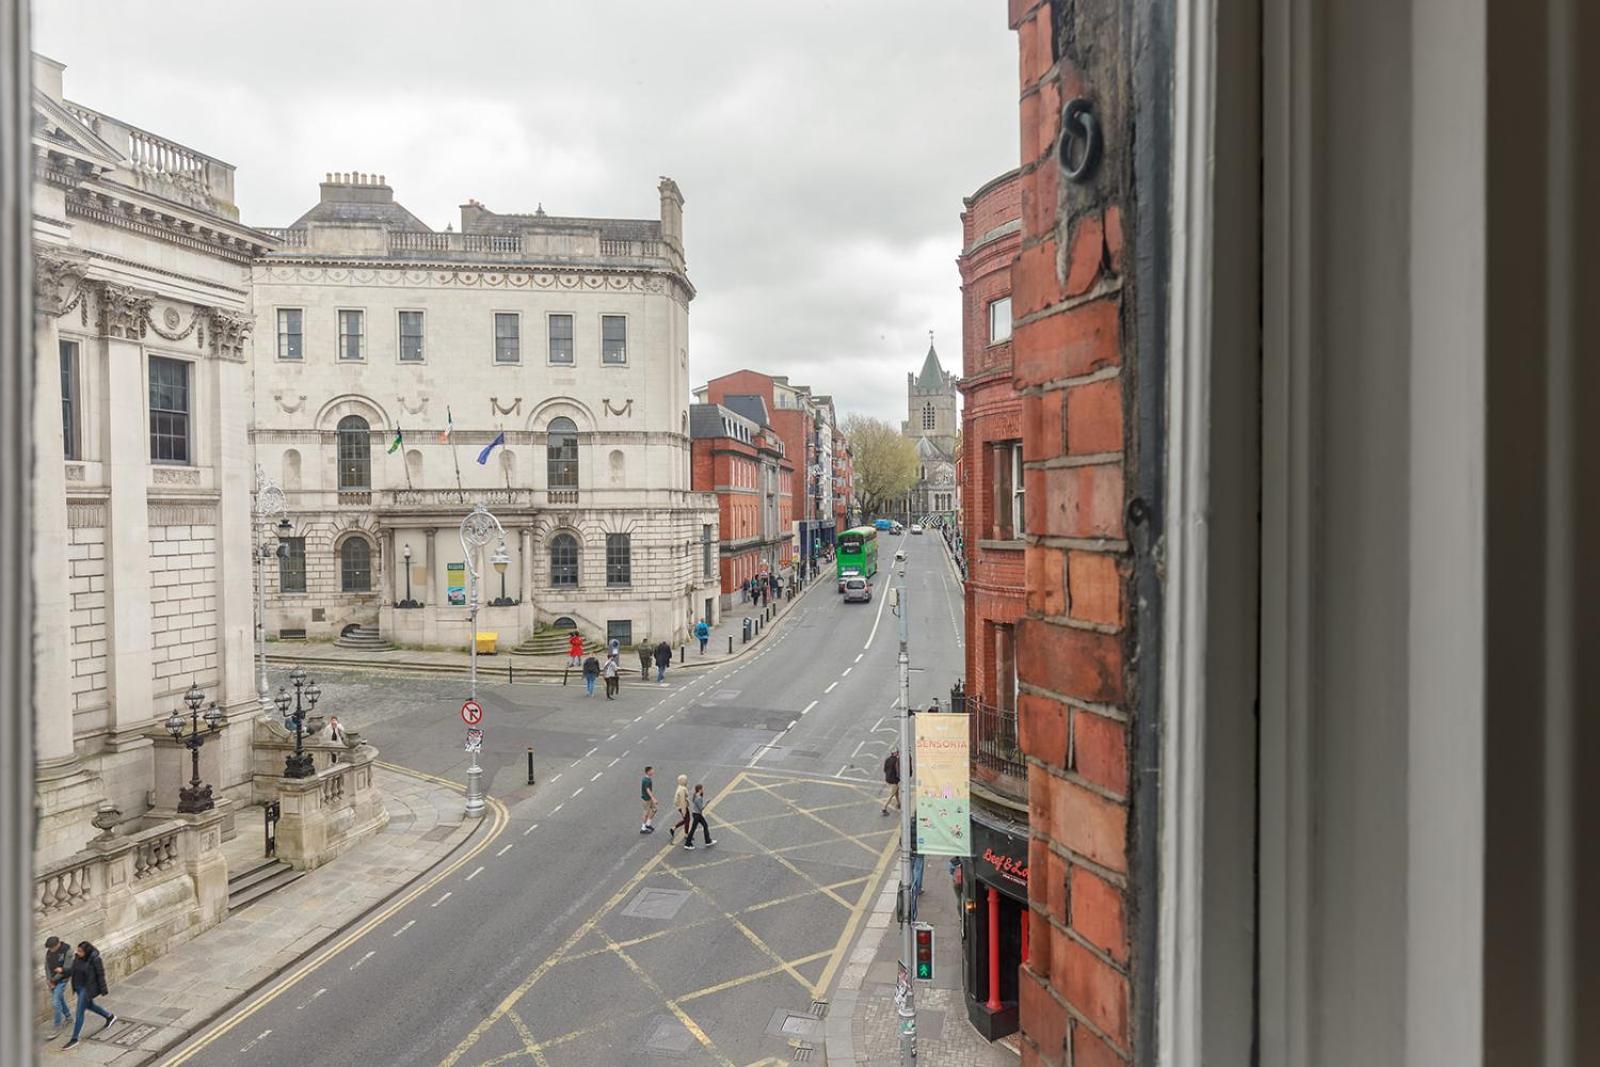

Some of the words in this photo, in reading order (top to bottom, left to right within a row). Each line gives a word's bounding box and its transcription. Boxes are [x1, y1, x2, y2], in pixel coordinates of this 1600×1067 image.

[917, 740, 967, 748] SENSORIA
[1003, 857, 1012, 870] &
[1010, 860, 1028, 877] Lo
